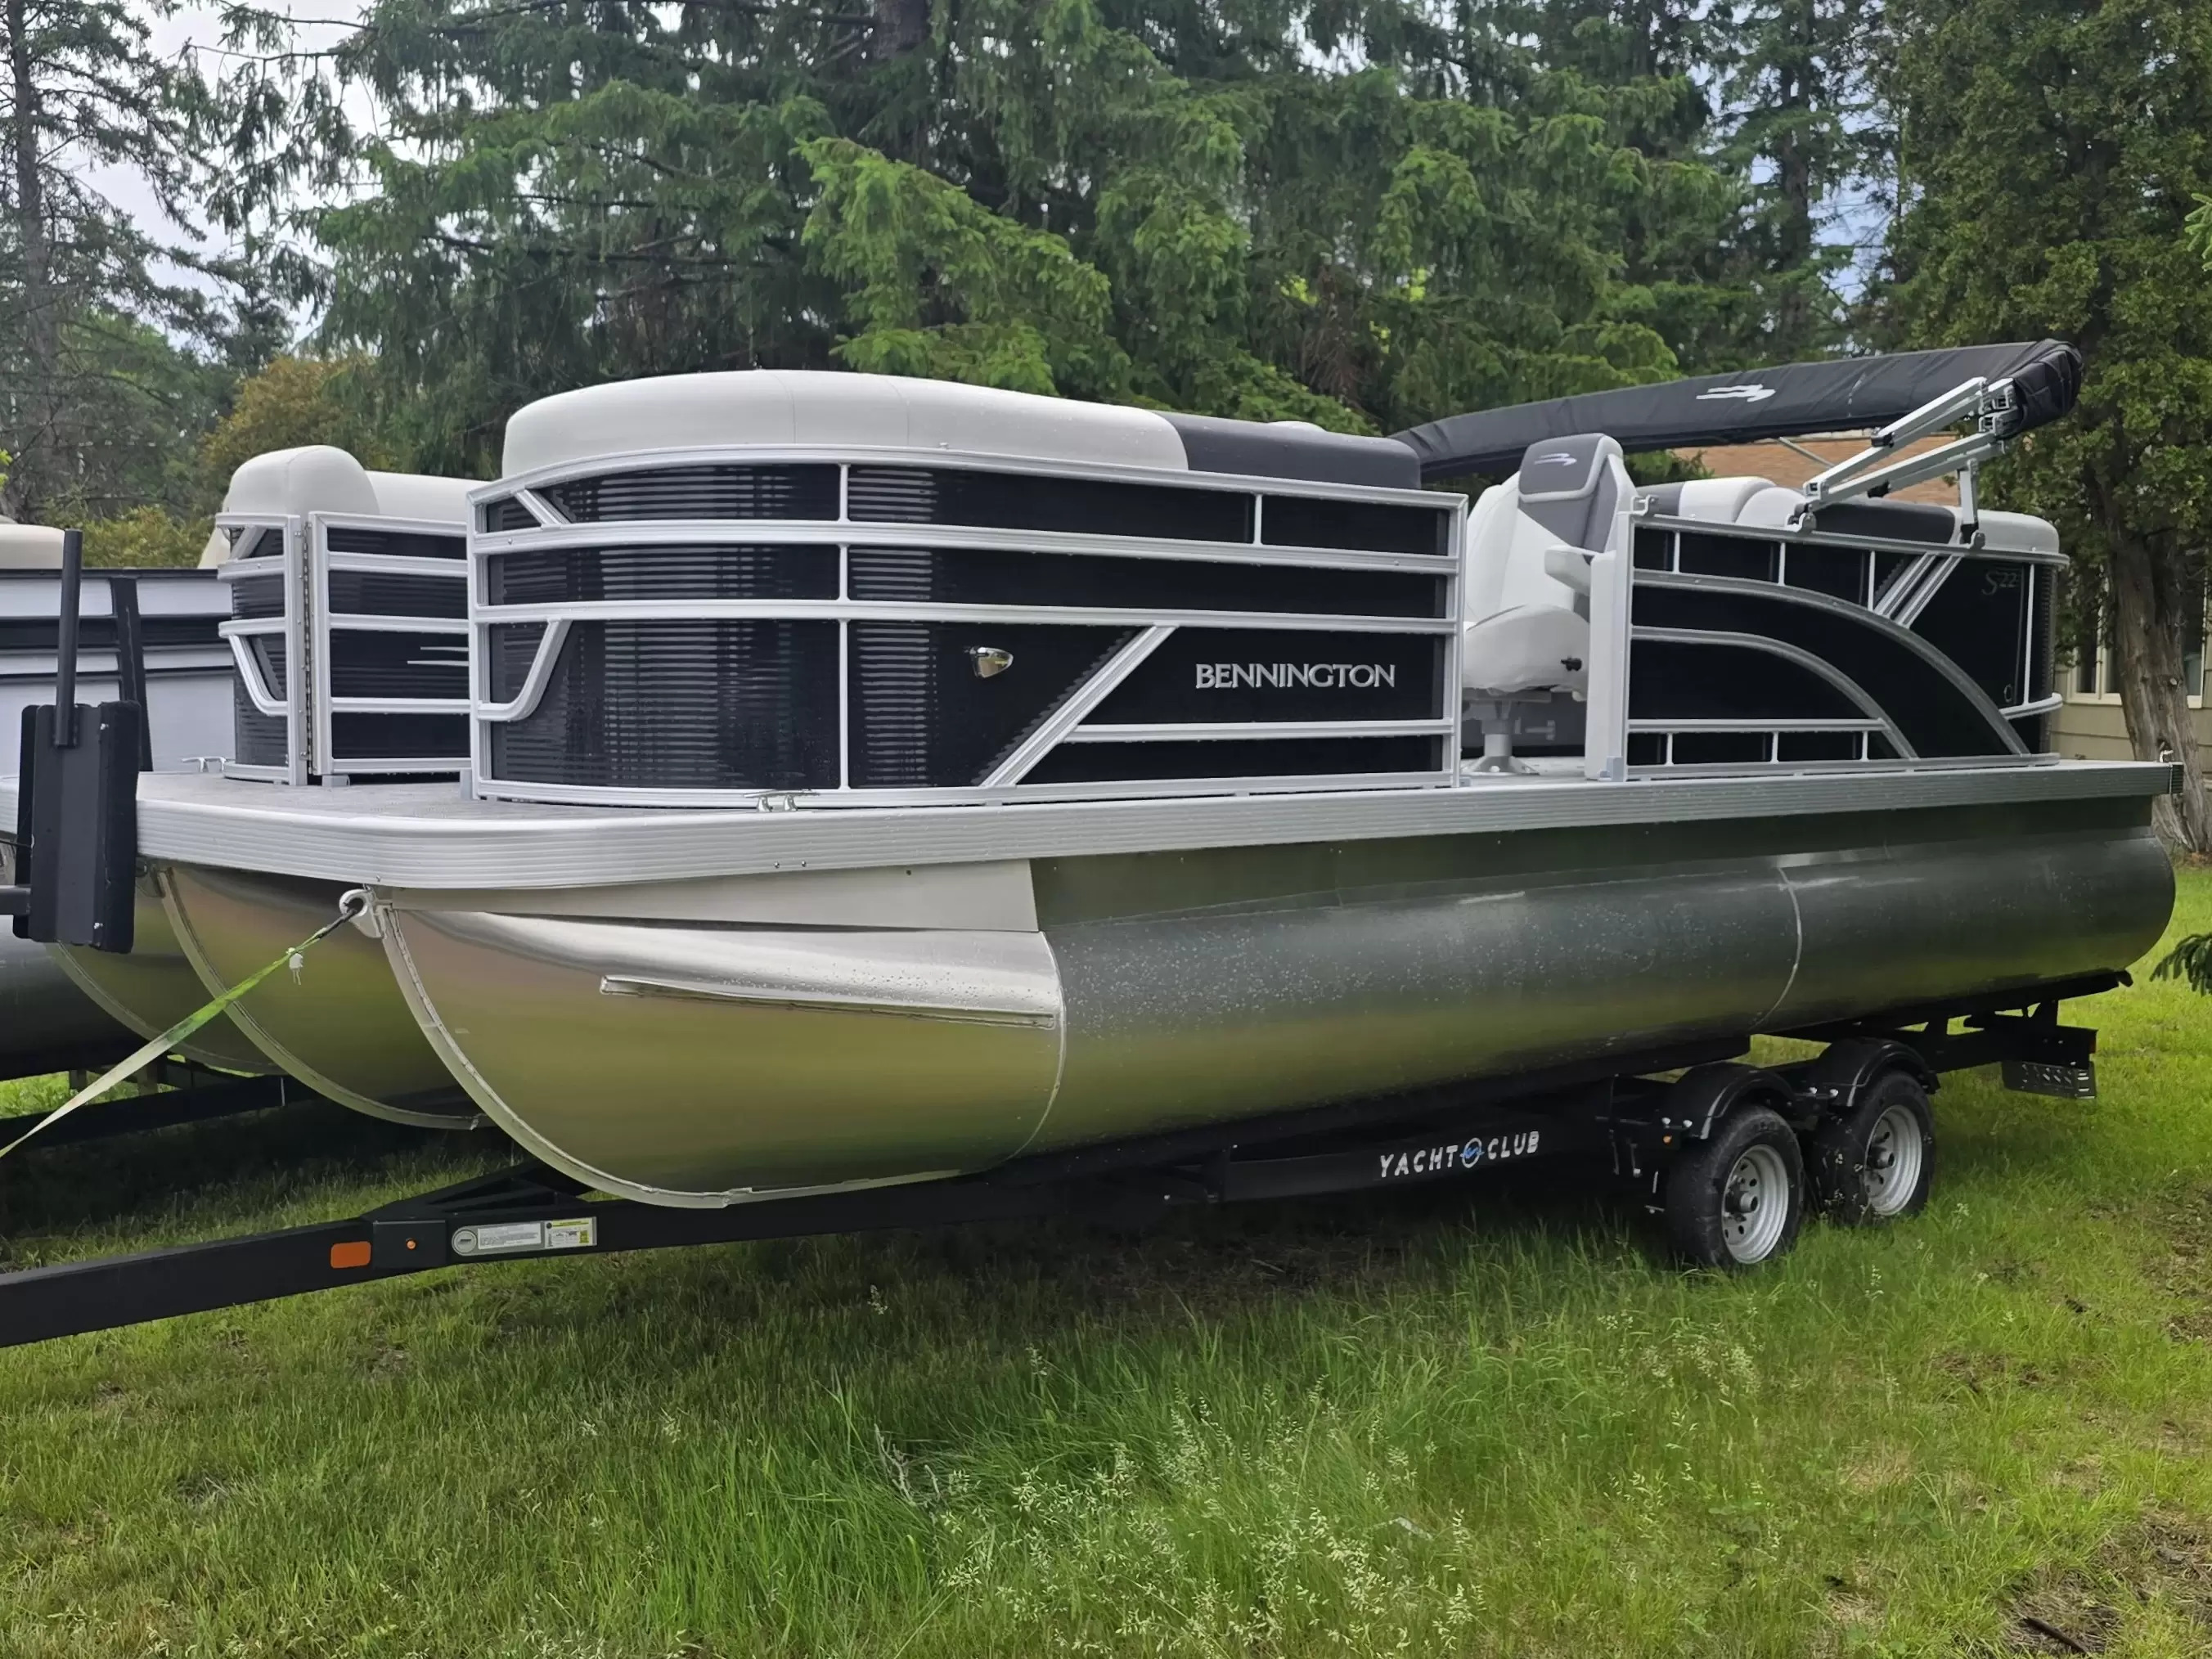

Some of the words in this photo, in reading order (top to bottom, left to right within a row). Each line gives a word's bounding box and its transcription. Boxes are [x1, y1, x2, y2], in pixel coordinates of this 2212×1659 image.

[1195, 663, 1396, 689] BENNINGTON
[1380, 1144, 1459, 1178] YACHT
[1487, 1131, 1540, 1160] CLUB
